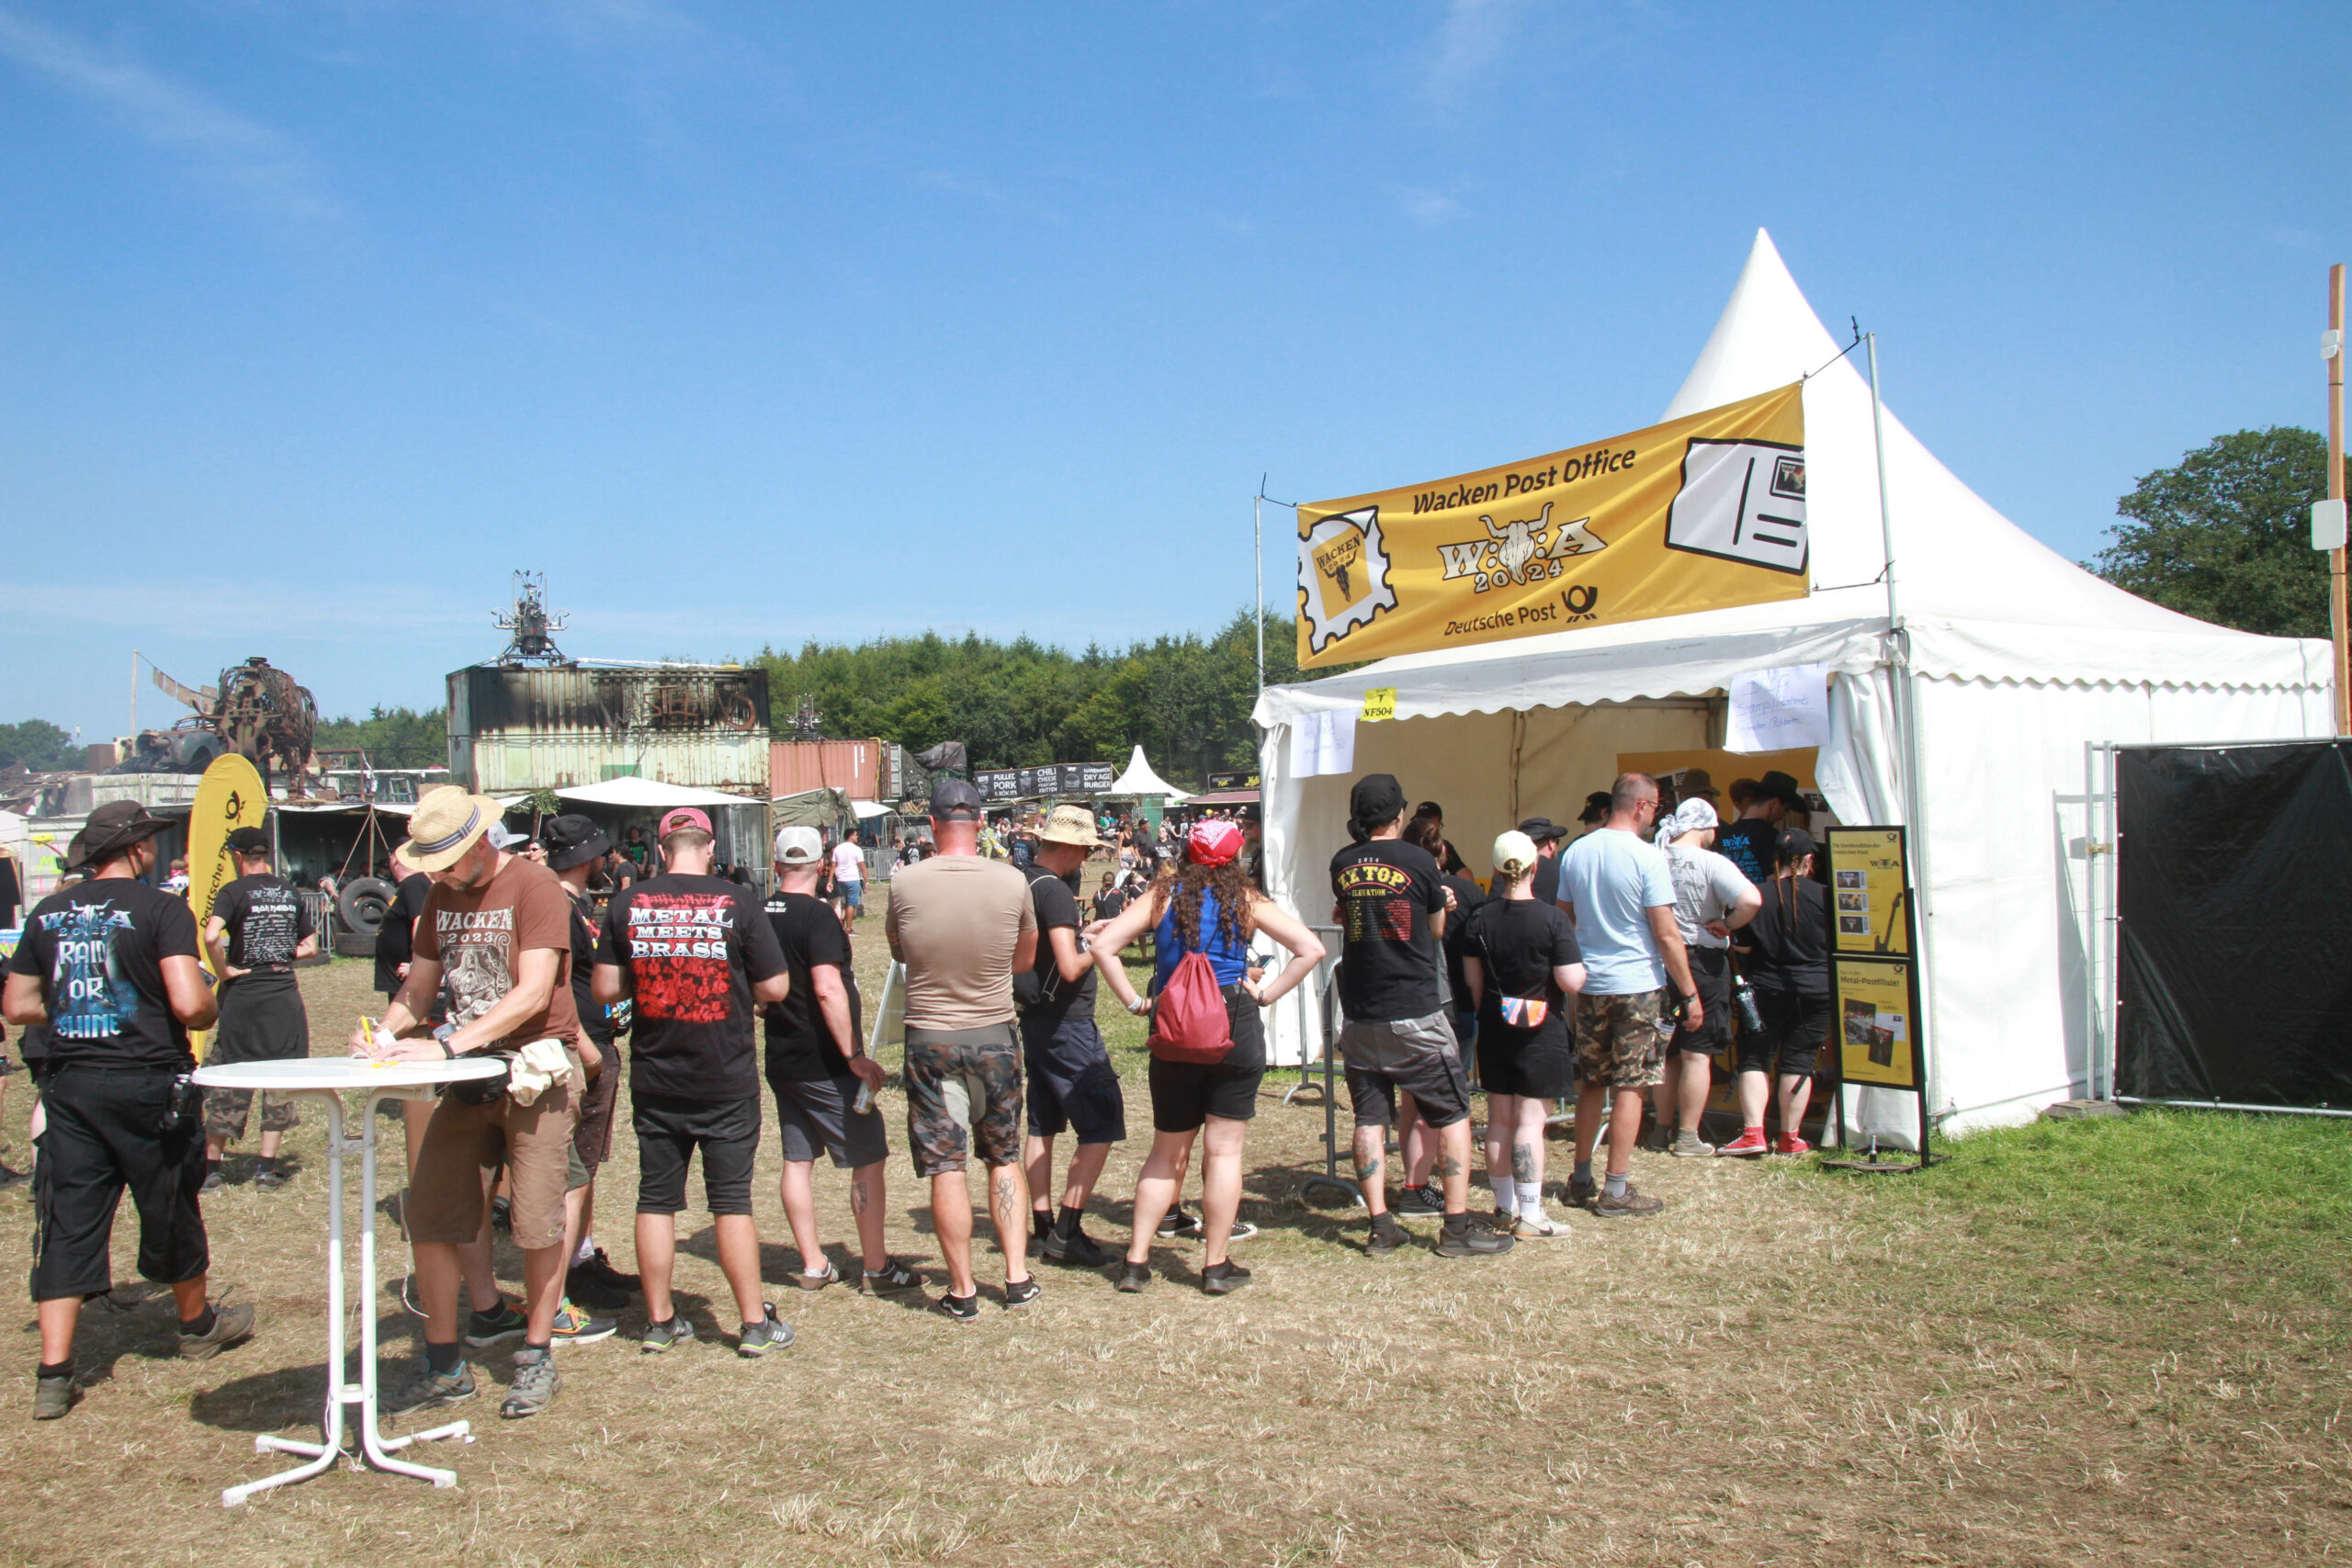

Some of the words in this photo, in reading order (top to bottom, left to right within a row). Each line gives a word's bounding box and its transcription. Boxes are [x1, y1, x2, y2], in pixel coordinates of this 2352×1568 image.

[1413, 483, 1498, 515] Wacken
[1503, 466, 1557, 498] Post
[1563, 448, 1636, 483] Office
[1316, 533, 1361, 570] WACKEN
[1443, 610, 1515, 637] Deutsche
[1517, 603, 1557, 625] Post
[1363, 706, 1393, 717] NF504
[1036, 767, 1057, 777] CHILI
[1083, 773, 1098, 782] DRY
[1098, 773, 1112, 781] AGE
[993, 781, 1017, 790] PORK
[1083, 781, 1111, 789] BURGER
[1337, 867, 1361, 891] ZZ
[1362, 865, 1407, 887] TOP
[198, 862, 225, 931] Deutsche
[1351, 888, 1386, 897] ELEVATION
[436, 905, 514, 932] WACKEN
[628, 907, 734, 929] METAL
[447, 931, 494, 944] 2023
[635, 926, 723, 940] MEETS
[629, 940, 729, 961] BRASS
[69, 977, 105, 1000] OR
[57, 1013, 122, 1039] SHINE
